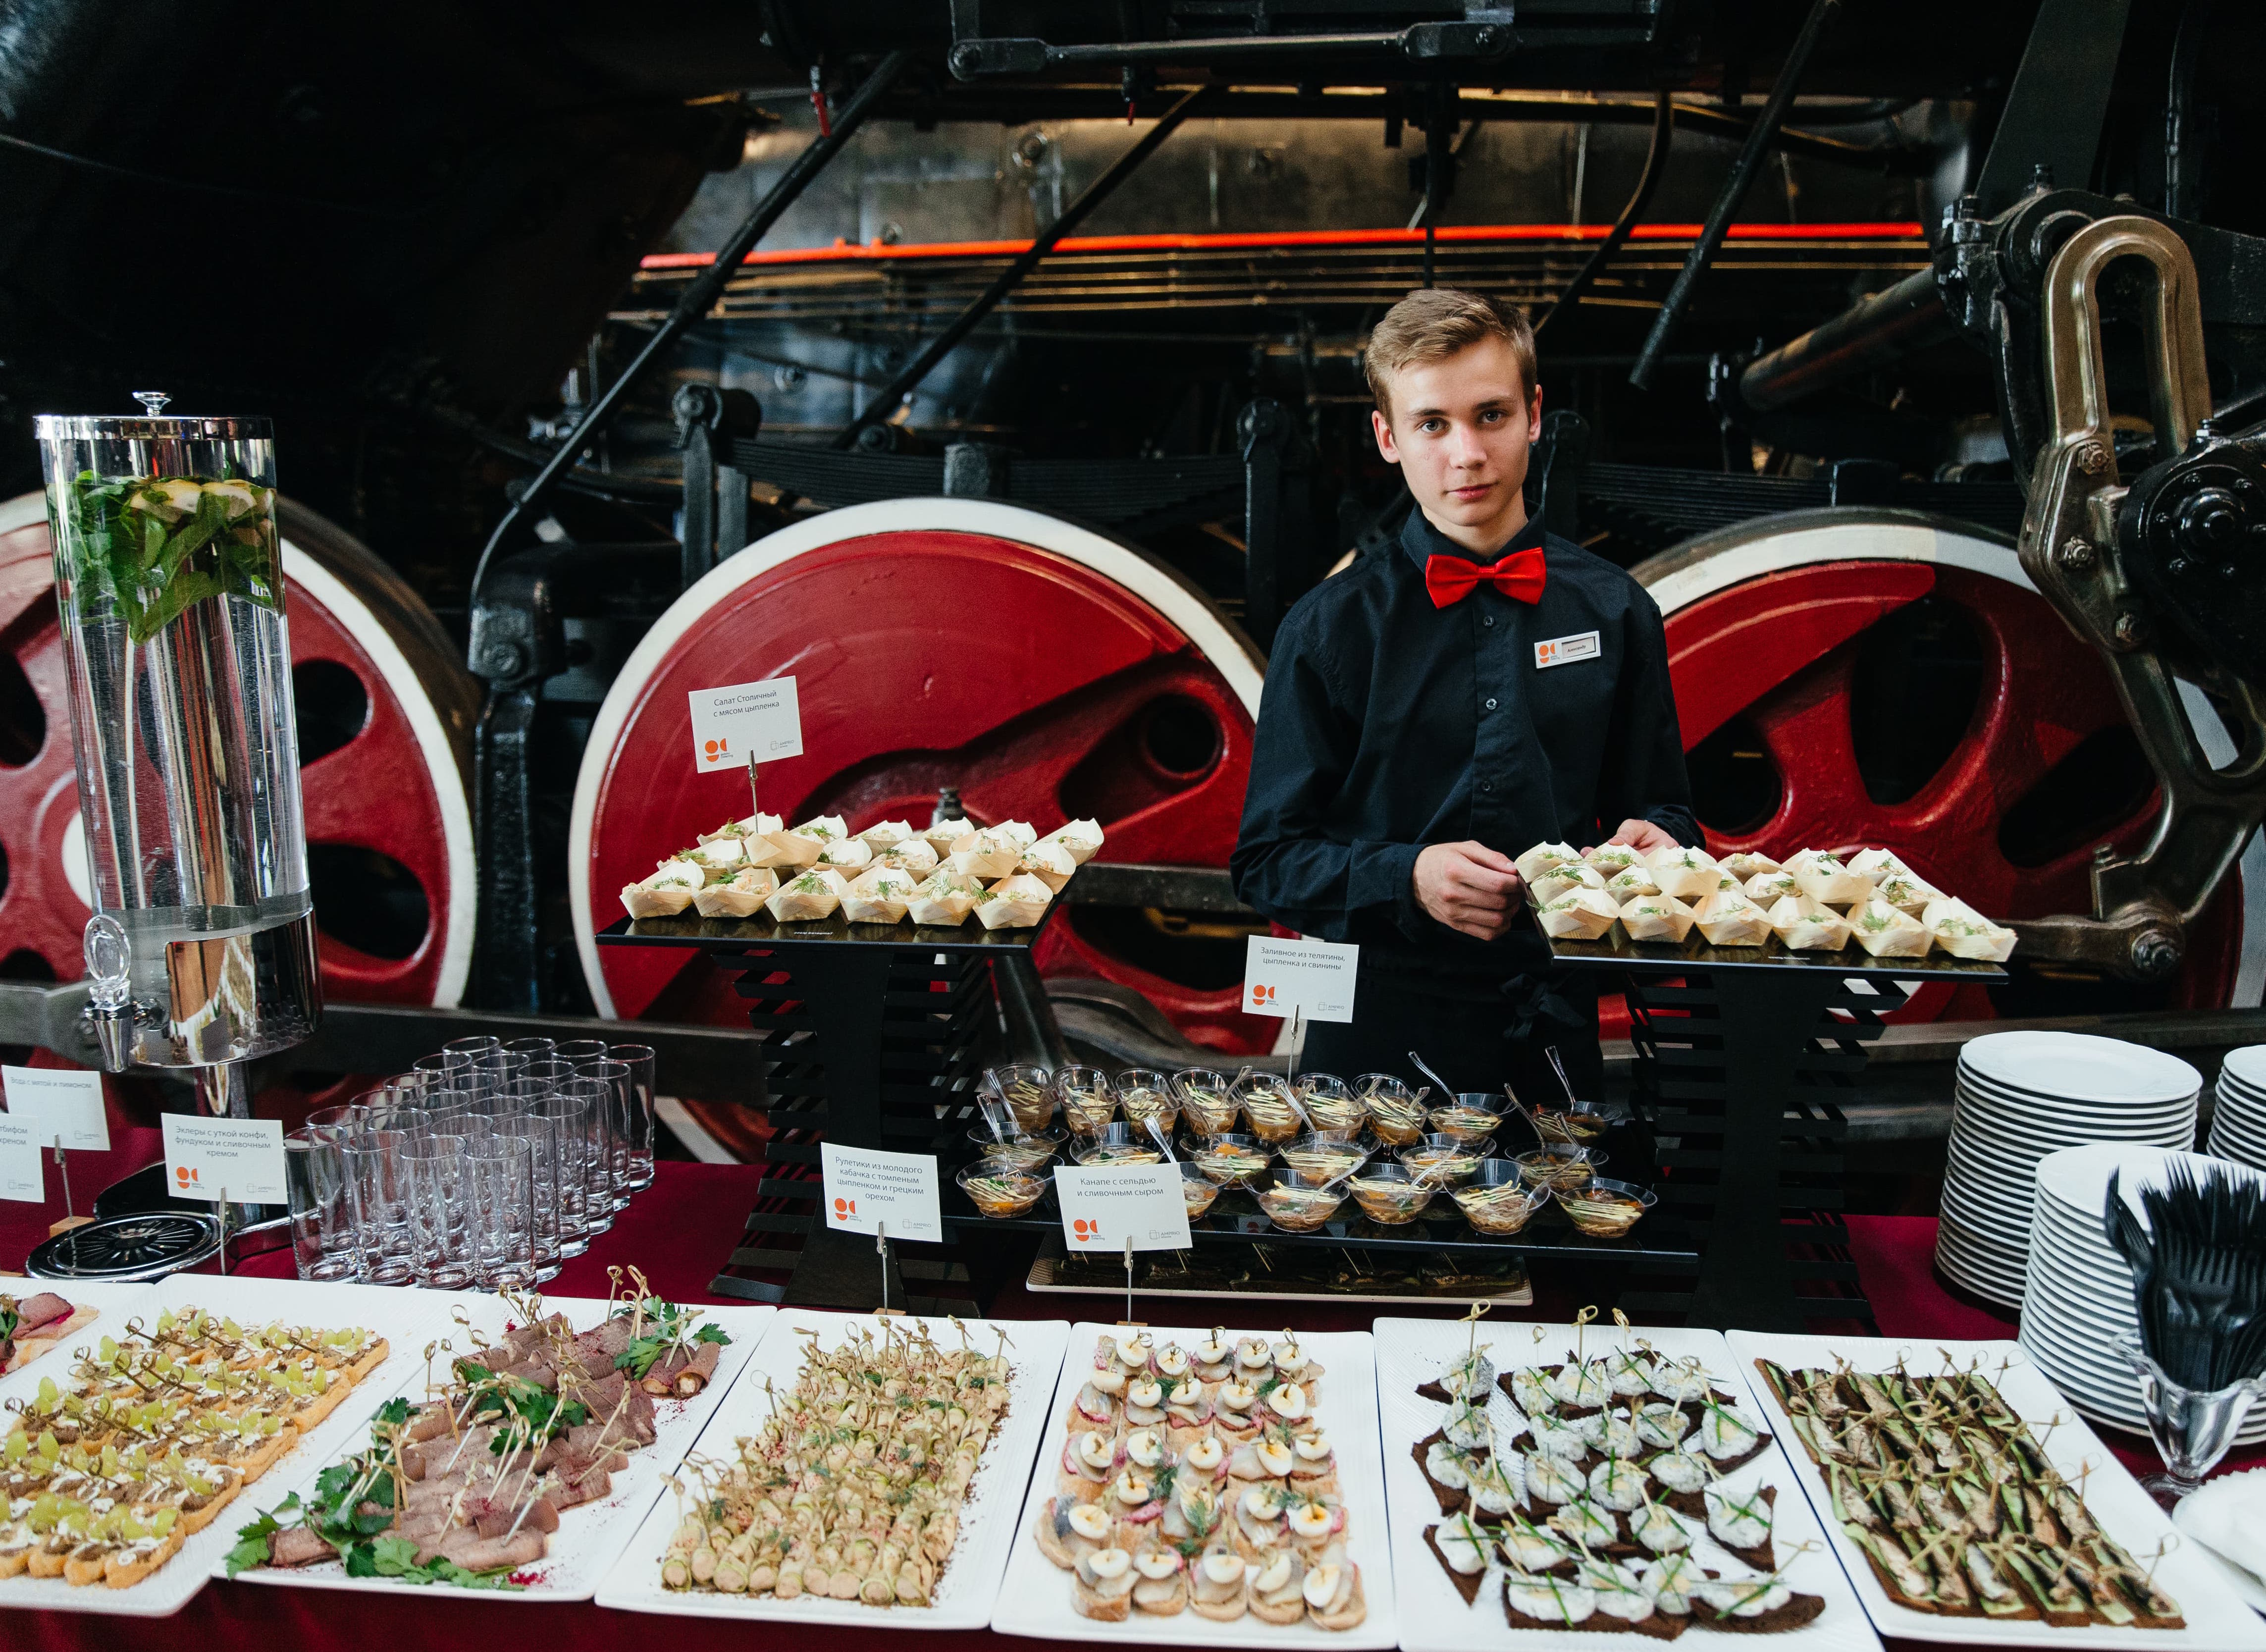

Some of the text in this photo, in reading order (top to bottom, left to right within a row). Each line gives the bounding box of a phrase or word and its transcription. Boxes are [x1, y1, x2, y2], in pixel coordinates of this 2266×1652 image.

[737, 690, 777, 702] Столичный
[719, 708, 743, 716] мясом
[744, 701, 780, 713] цыпленка
[1261, 947, 1297, 957] Заливное
[1309, 953, 1345, 962] телятины,
[1263, 958, 1300, 966] цыпленка
[175, 1125, 206, 1136] Эклеры
[239, 1131, 268, 1139] конфи,
[222, 1140, 271, 1149] сливочным
[207, 1149, 238, 1158] кремом
[836, 1156, 870, 1169] Рулетики
[883, 1165, 923, 1174] молодого
[840, 1169, 870, 1178] кабачка
[877, 1174, 919, 1184] томленым
[837, 1178, 881, 1189] цыпленком
[890, 1185, 924, 1195] грецким
[865, 1193, 895, 1202] орехом
